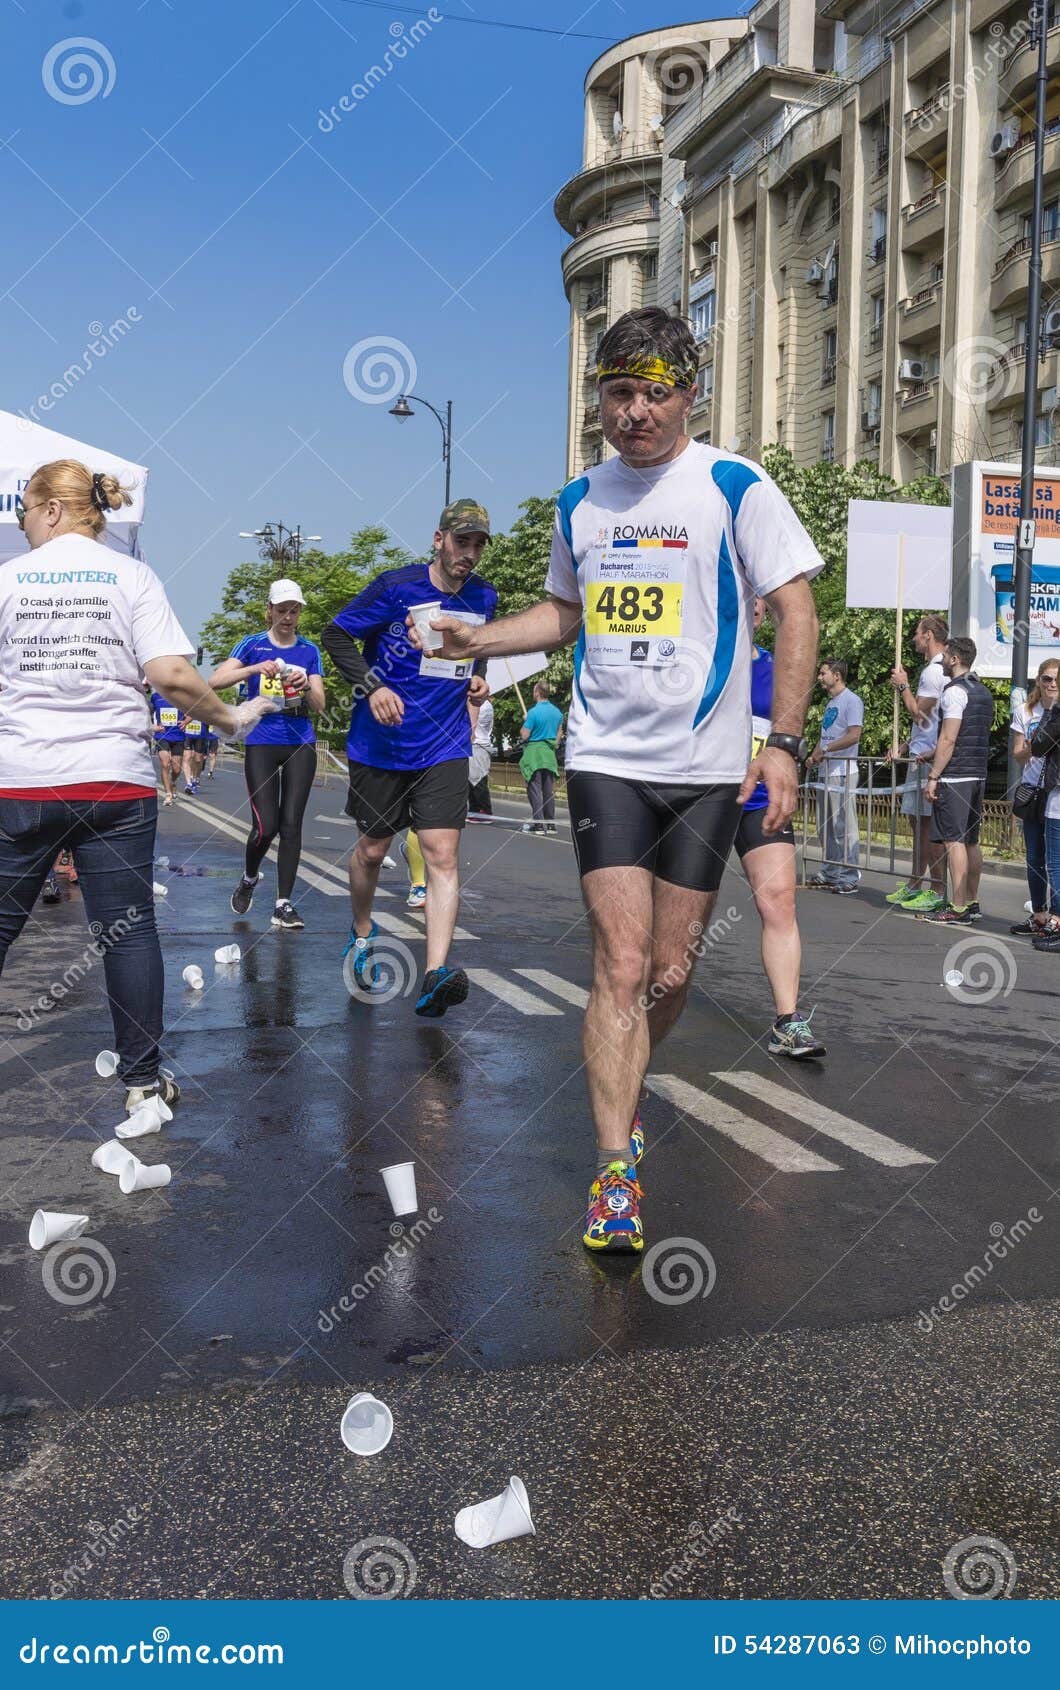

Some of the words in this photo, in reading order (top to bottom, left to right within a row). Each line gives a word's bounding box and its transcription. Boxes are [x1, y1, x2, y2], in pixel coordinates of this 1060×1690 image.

[1036, 486, 1053, 501] să
[613, 525, 689, 540] ROMANIA
[600, 563, 634, 571] Bucharest
[16, 570, 118, 585] VOLUNTEER
[600, 571, 619, 579] HALF
[622, 570, 669, 580] MARATHON
[20, 597, 29, 606] O
[73, 597, 109, 606] familie
[595, 586, 664, 621] 483
[16, 611, 49, 621] pentru
[51, 611, 84, 620] fiecare
[86, 611, 112, 620] copil
[608, 623, 647, 634] MARIUS
[11, 635, 37, 645] world
[40, 635, 50, 645] in
[52, 634, 80, 645] which
[82, 635, 124, 647] children
[23, 650, 37, 658] no
[38, 649, 68, 660] longer
[69, 647, 98, 658] suffer
[20, 661, 78, 671] institutional
[80, 661, 101, 671] care
